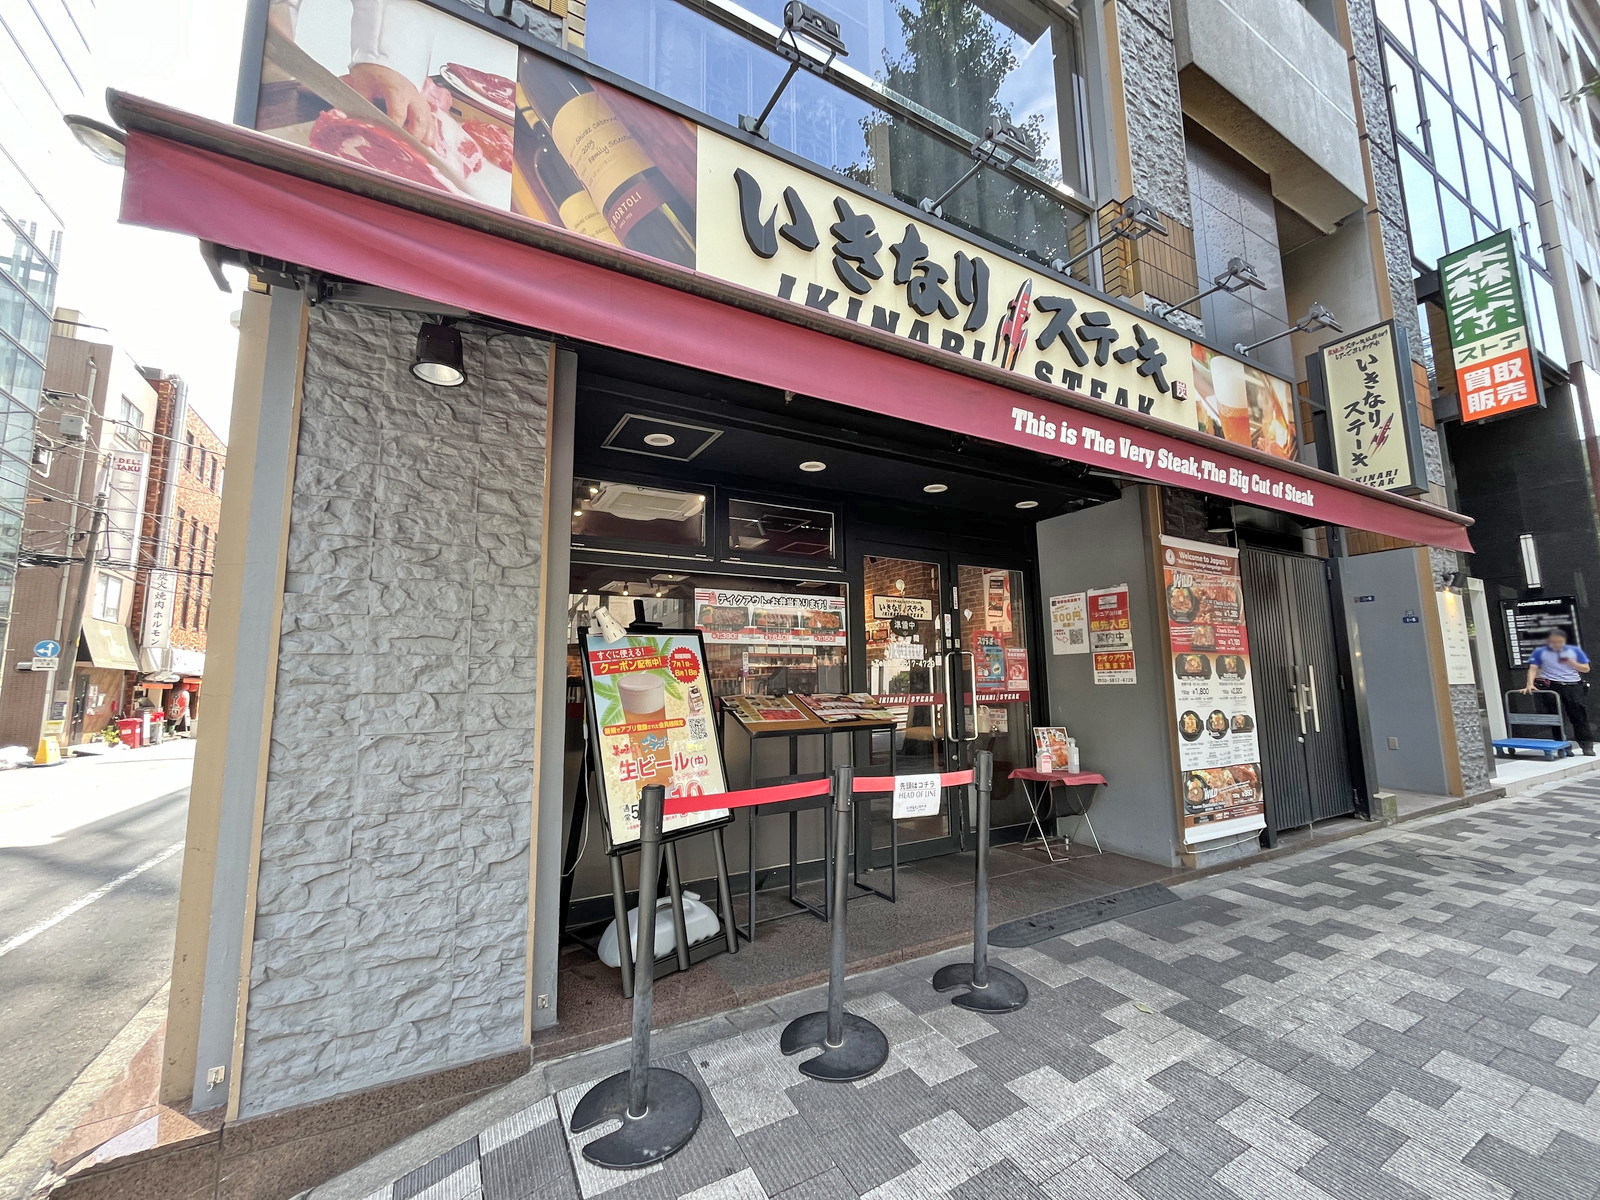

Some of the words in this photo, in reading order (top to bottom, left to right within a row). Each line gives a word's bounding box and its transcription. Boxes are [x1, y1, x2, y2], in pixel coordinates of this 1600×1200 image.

[611, 191, 642, 224] BORTOLI
[733, 167, 991, 333] いきなり
[1033, 294, 1172, 395] ステーキ
[1457, 332, 1521, 365] ストア
[1463, 357, 1525, 392] 買取
[1356, 354, 1386, 429] いきなり
[1466, 380, 1528, 414] 販売
[1343, 401, 1369, 468] ステーキ
[1011, 407, 1056, 441] This
[1060, 421, 1077, 446] is
[1081, 427, 1116, 456] The
[1119, 436, 1155, 469] Very
[1229, 466, 1250, 495] Big
[1251, 473, 1271, 496] Cut
[1272, 481, 1284, 499] of
[1285, 483, 1315, 507] Steak
[1351, 468, 1399, 483] KINARI
[1178, 551, 1203, 561] Welcome
[1090, 619, 1129, 631] 優先入店
[1096, 632, 1125, 643] 案内中
[1096, 654, 1132, 662] テイクアウト
[878, 695, 906, 704] IKINARI
[910, 695, 935, 703] STEAK
[999, 693, 1020, 701] STEAK
[900, 781, 935, 790] 先頭はコチラ
[898, 791, 915, 799] HEAD
[915, 790, 924, 798] OF
[924, 790, 937, 798] LINE
